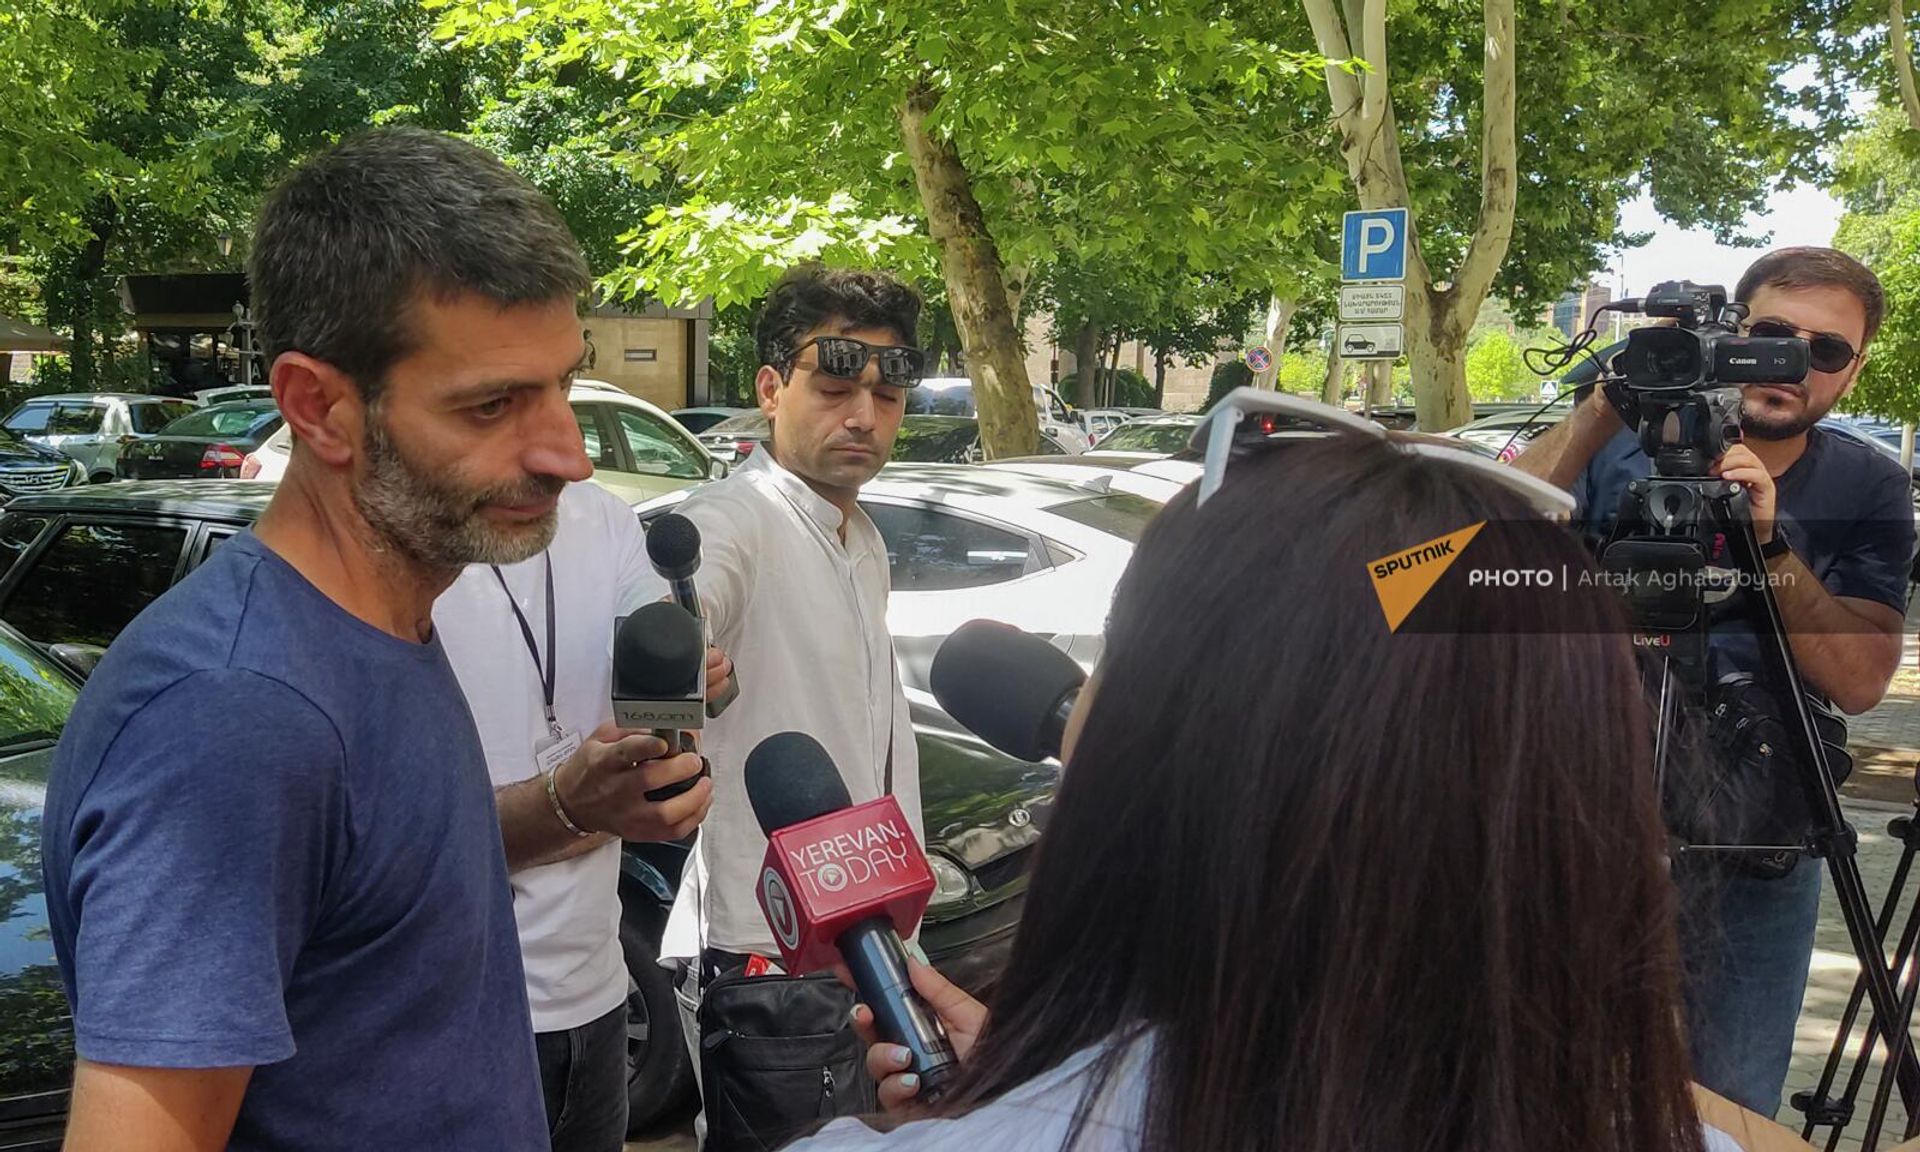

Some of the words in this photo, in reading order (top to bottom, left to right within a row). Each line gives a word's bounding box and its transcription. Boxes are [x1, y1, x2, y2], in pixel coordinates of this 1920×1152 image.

[1358, 218, 1395, 273] P
[1729, 357, 1757, 365] Canon
[1633, 634, 1670, 646] LiveU
[799, 841, 908, 896] TODAY
